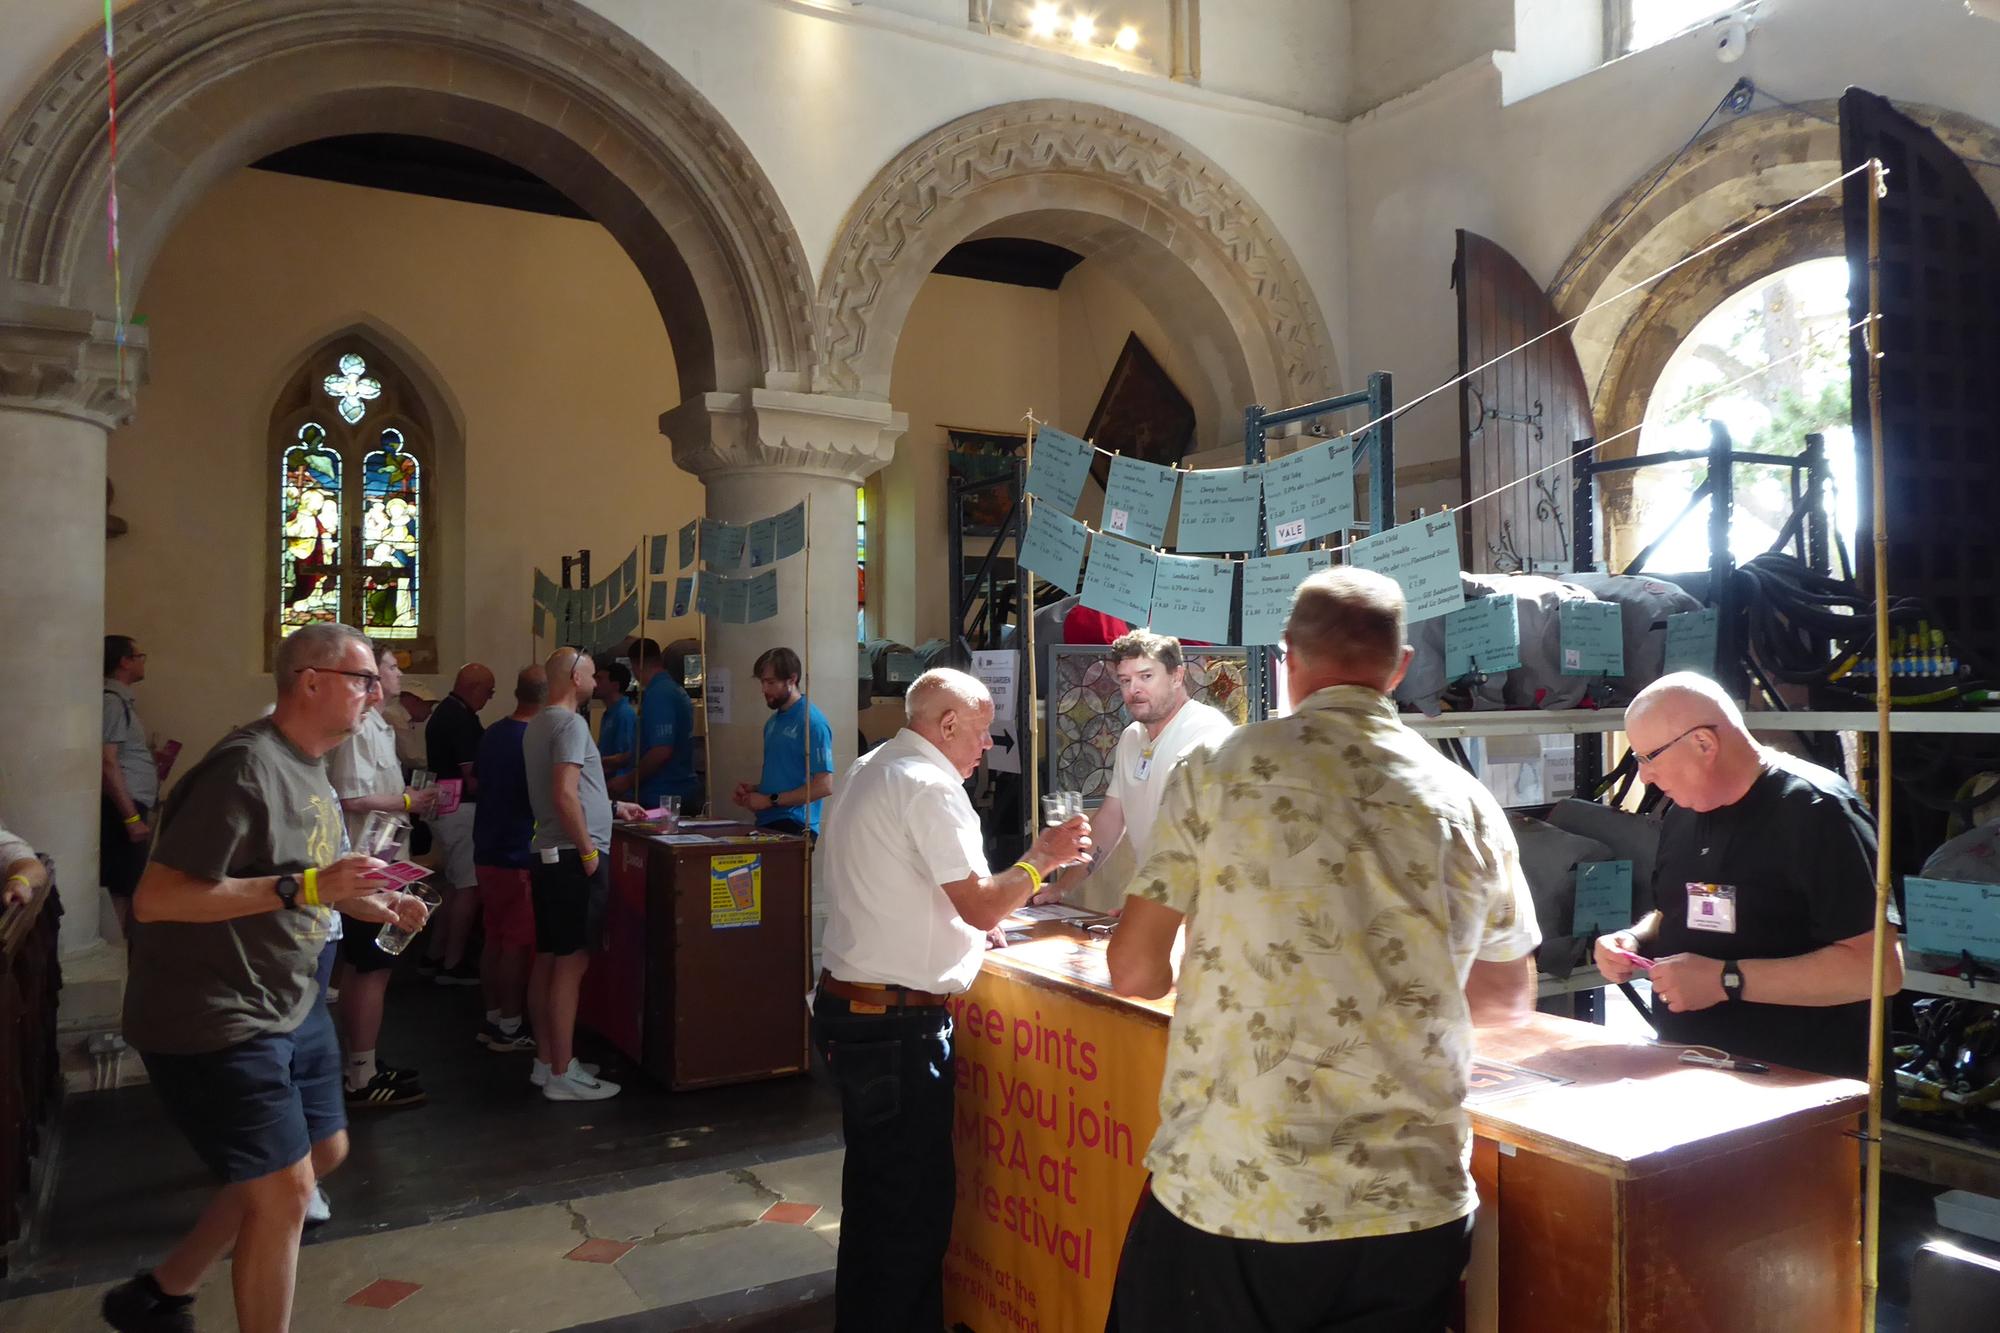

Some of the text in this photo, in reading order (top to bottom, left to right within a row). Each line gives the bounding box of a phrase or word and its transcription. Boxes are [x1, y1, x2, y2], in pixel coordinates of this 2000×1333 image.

[1279, 525, 1303, 537] VALE
[948, 997, 1098, 1081] ree pints
[952, 1103, 1078, 1205] MRA at
[999, 1071, 1057, 1132] you
[1067, 1086, 1134, 1166] join
[974, 1166, 1093, 1279] festival
[995, 1269, 1011, 1292] at
[1014, 1276, 1037, 1310] the
